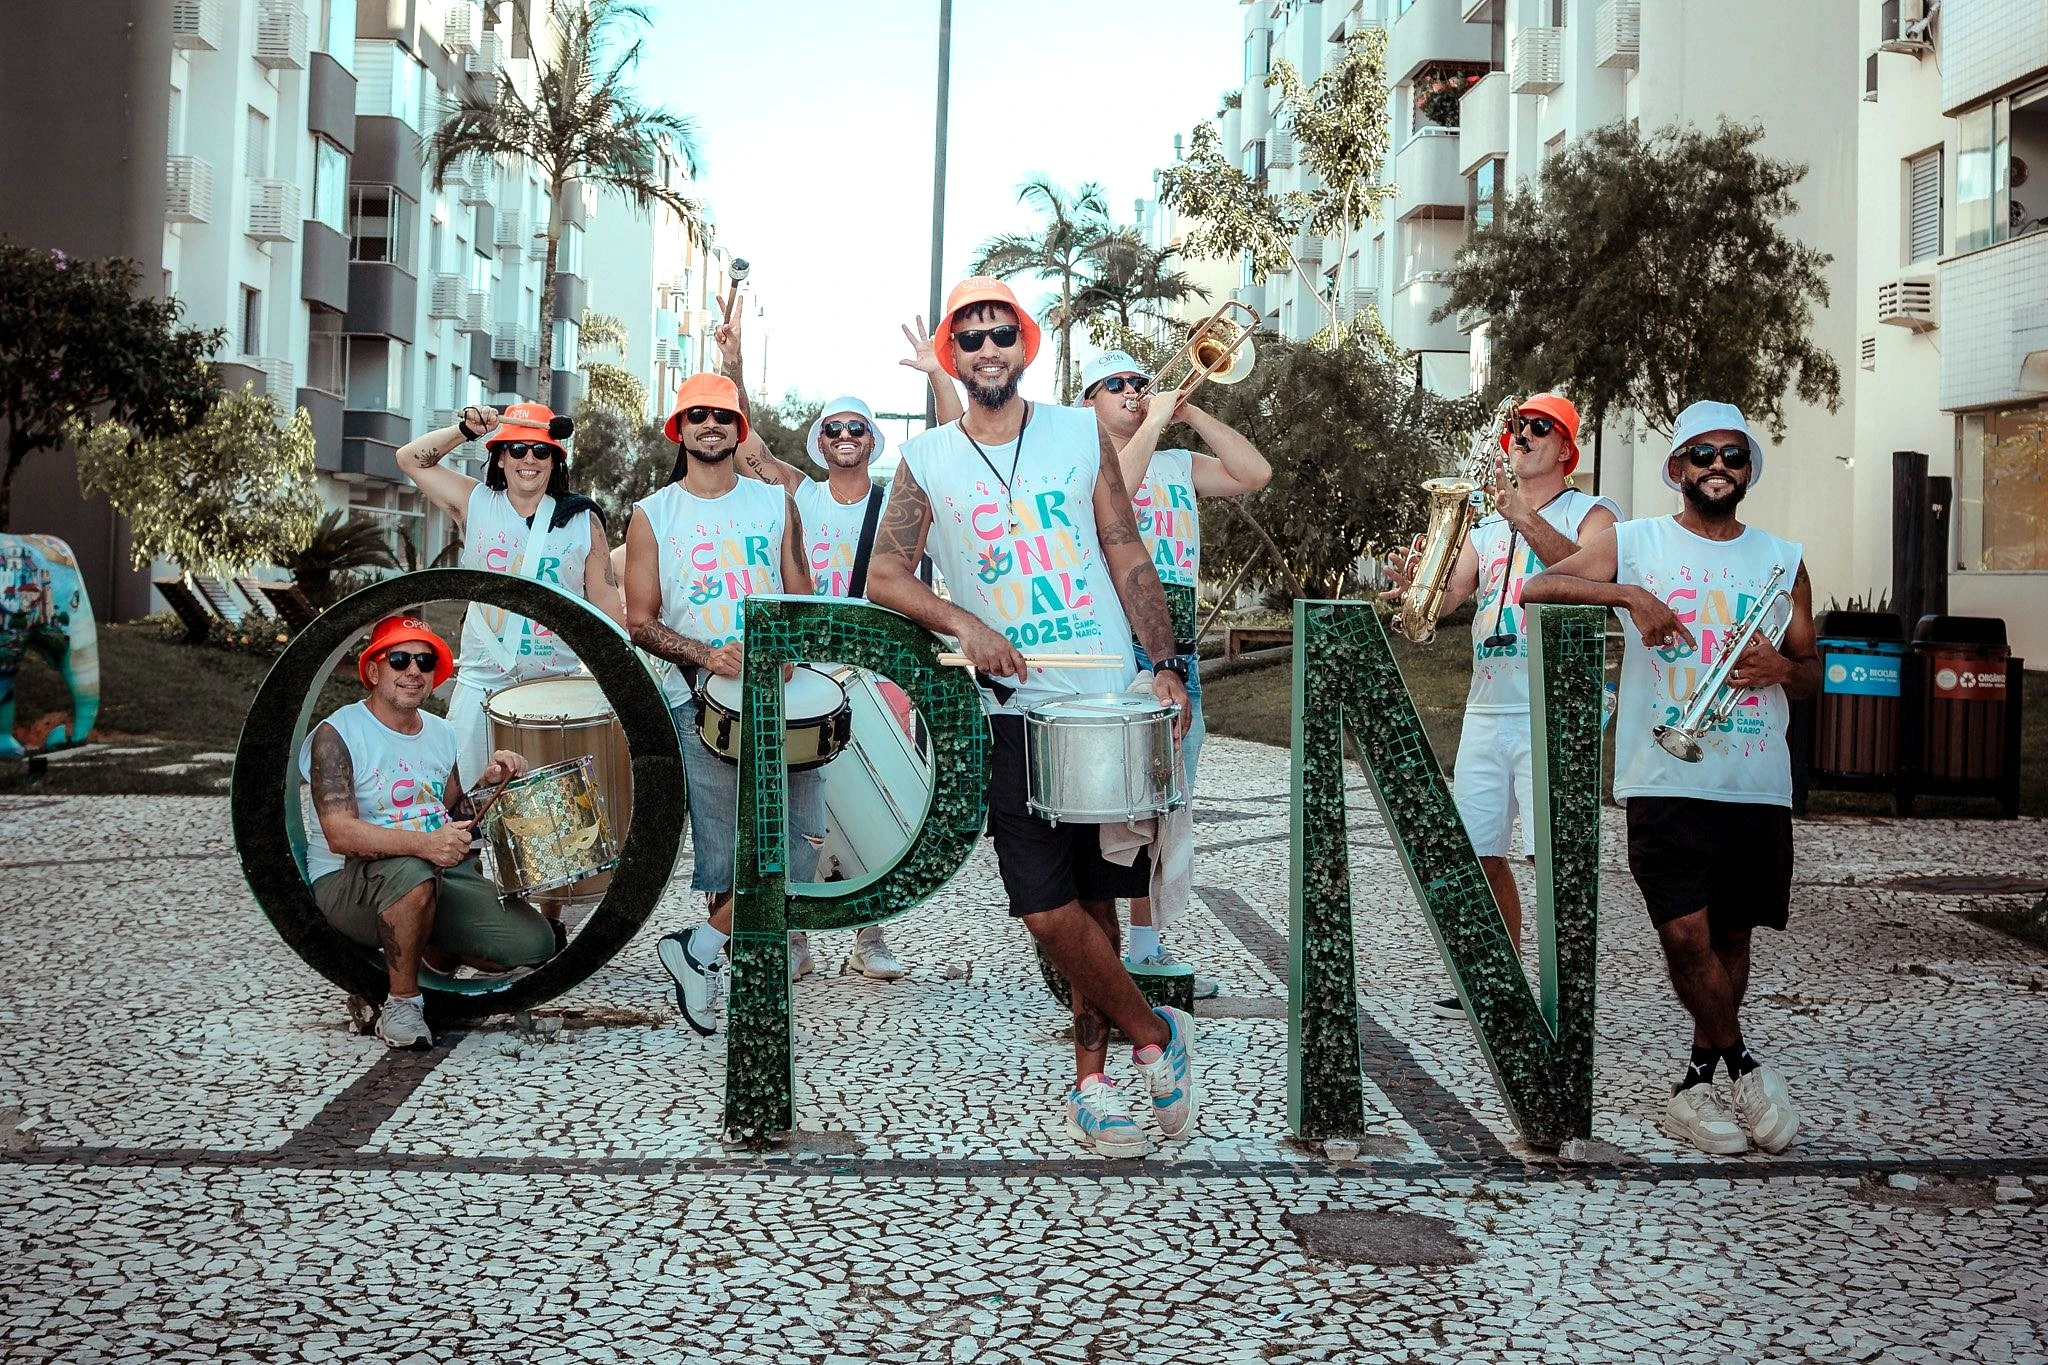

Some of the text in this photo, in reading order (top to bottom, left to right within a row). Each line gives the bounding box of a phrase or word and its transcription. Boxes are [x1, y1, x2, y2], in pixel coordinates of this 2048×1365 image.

[1098, 354, 1124, 364] OPEN
[509, 409, 530, 419] OPEN
[971, 490, 1072, 541] CAR
[1154, 510, 1193, 538] NA
[690, 535, 770, 571] CAR
[811, 542, 854, 570] CA
[1014, 530, 1081, 575] NA
[1005, 616, 1073, 648] 2025
[1074, 619, 1099, 630] CAMP
[229, 568, 1607, 1149] OPN
